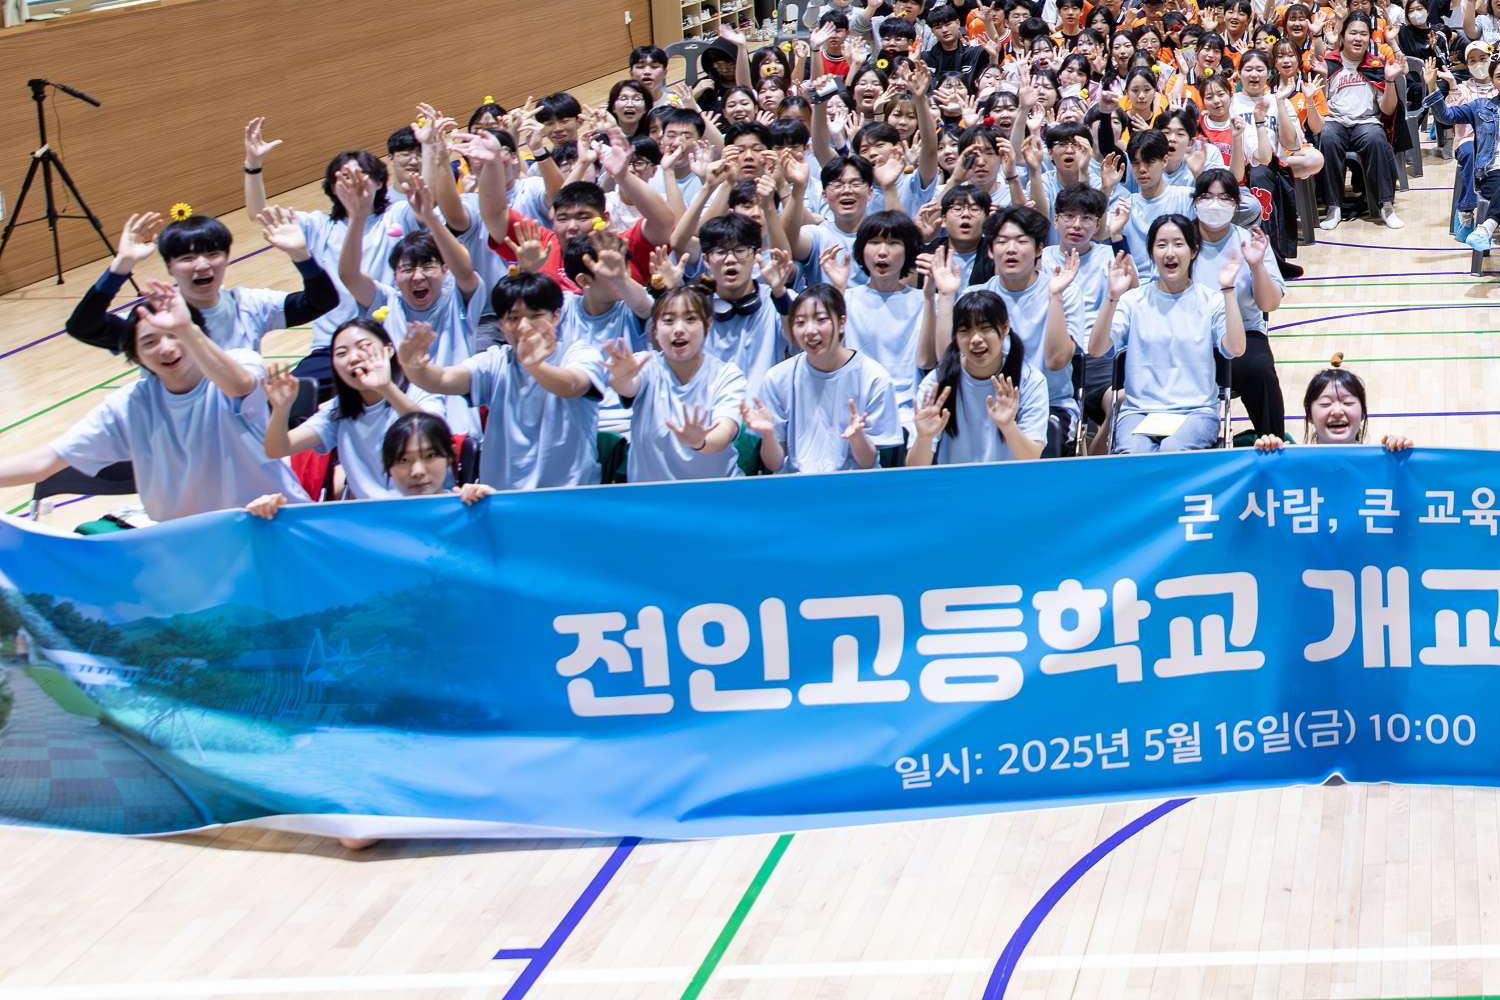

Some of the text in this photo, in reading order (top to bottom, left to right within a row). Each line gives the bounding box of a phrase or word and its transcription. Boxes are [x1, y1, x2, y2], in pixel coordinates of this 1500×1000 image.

[1178, 494, 1220, 541] 큰
[1239, 487, 1337, 534] 사람,
[1358, 488, 1400, 534] 큰
[553, 573, 1266, 716] 전인고등학교
[895, 747, 983, 789] 일시:
[998, 728, 1130, 774] 2025년
[1145, 721, 1202, 764] 5월
[1215, 710, 1356, 755] 16일(금)
[1370, 713, 1476, 746] 10:00
